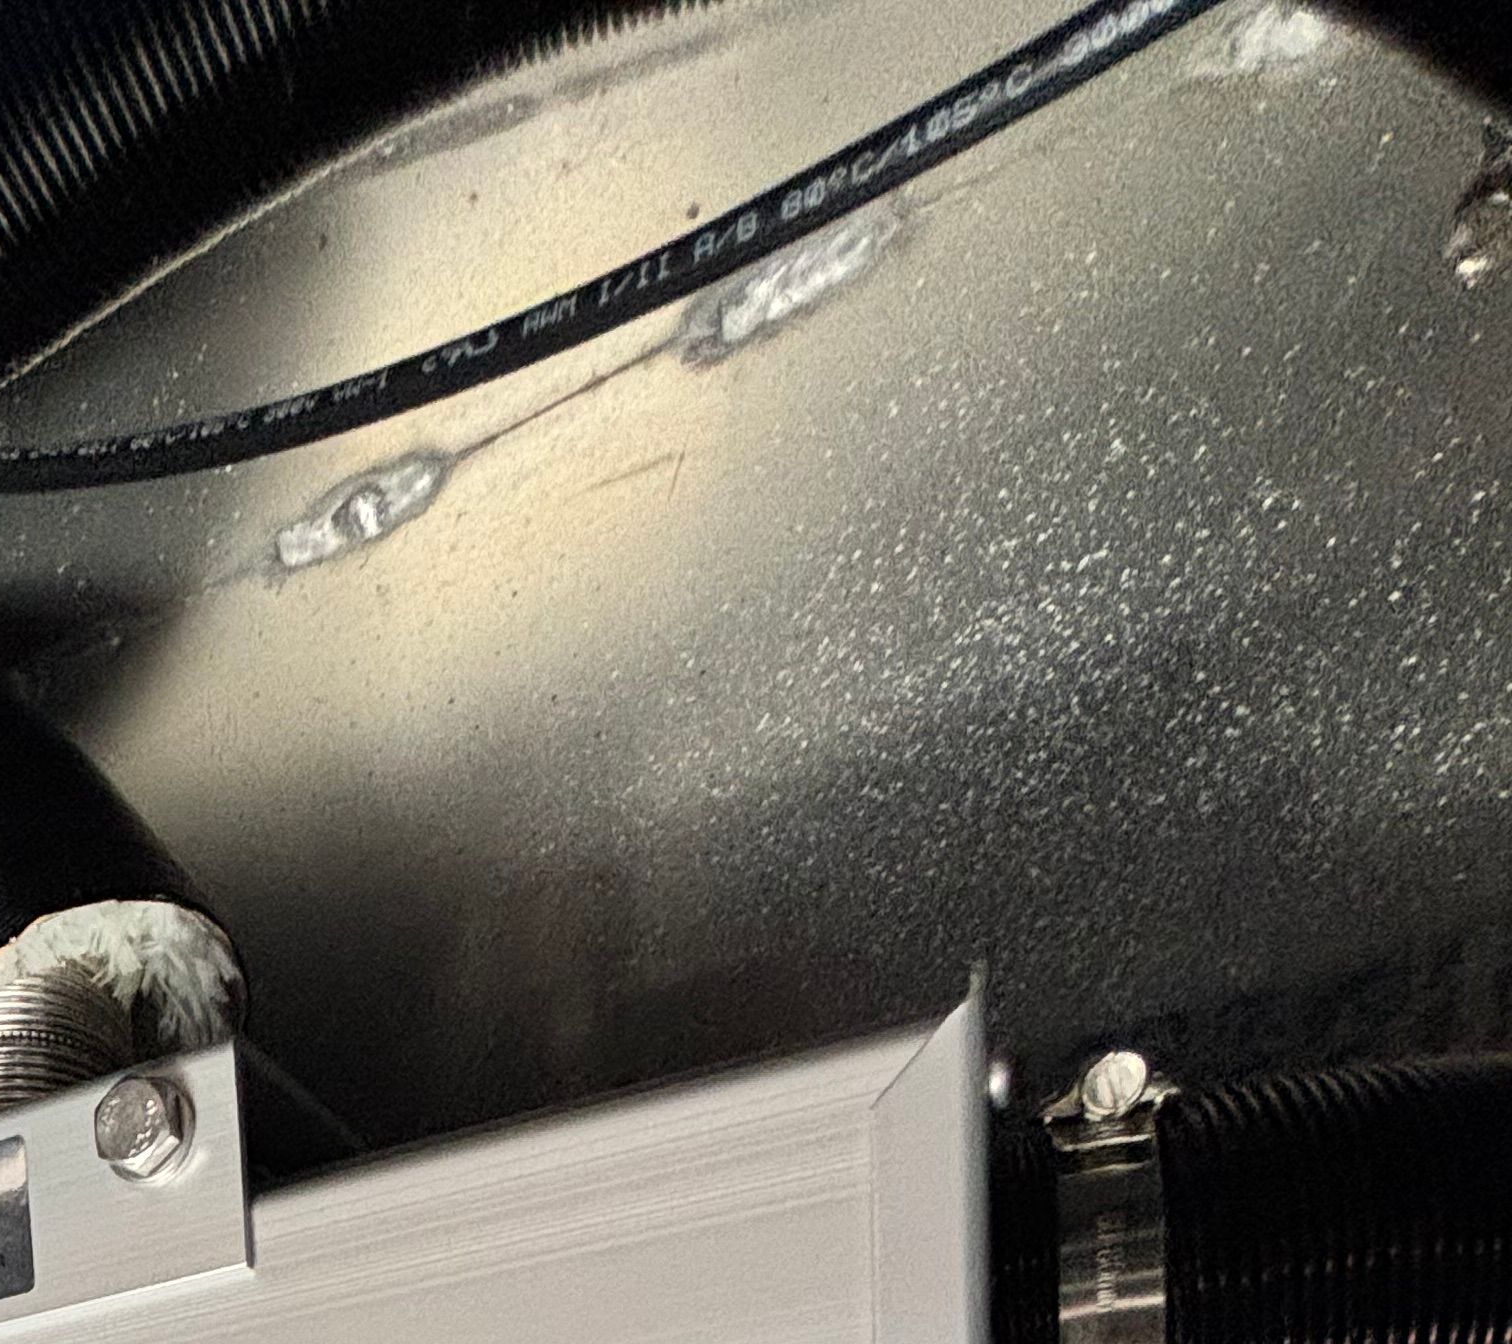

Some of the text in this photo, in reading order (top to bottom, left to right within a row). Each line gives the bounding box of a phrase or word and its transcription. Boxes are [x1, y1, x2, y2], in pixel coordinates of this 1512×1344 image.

[522, 294, 578, 338] AWM
[597, 250, 671, 307] I/II
[692, 211, 759, 266] A/B
